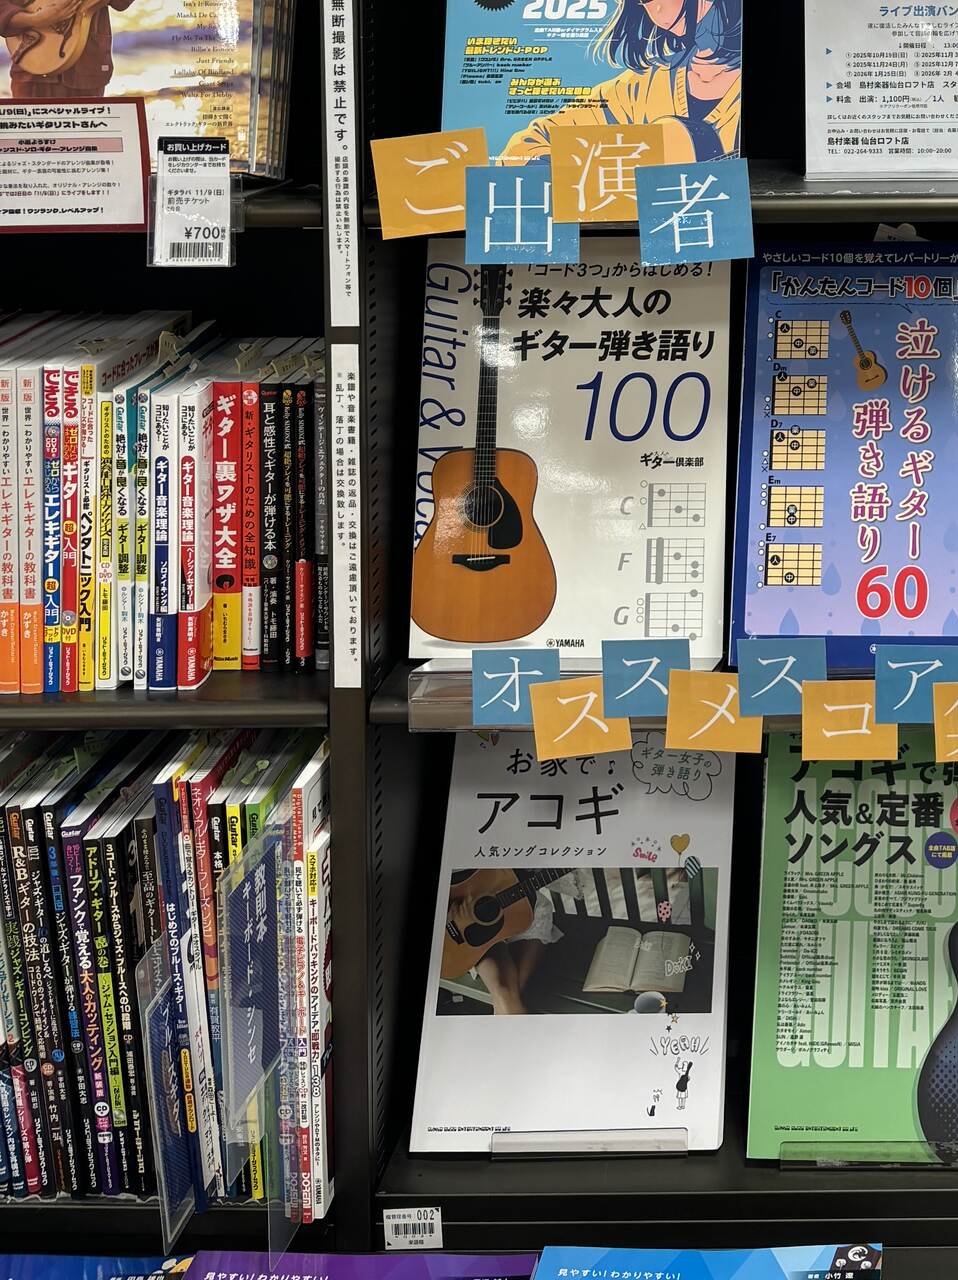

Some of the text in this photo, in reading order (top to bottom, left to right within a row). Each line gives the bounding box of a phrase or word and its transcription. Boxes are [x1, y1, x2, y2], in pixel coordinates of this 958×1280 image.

[836, 81, 851, 89] 会場
[859, 81, 935, 89] 島村楽器仙台ロフト店
[836, 95, 851, 103] 料金
[166, 143, 227, 152] お買い上げカード
[827, 137, 909, 145] 島村楽器 仙台ロフト店
[403, 133, 730, 254] ご出演者
[184, 227, 220, 239] ¥700
[517, 287, 672, 319] 楽々大人の
[512, 329, 716, 362] ギター弾き語り
[44, 370, 61, 418] できる
[575, 371, 712, 442] 100
[896, 319, 940, 561] 泣けるギター
[639, 452, 704, 469] ギター倶楽部
[214, 393, 237, 569] ギター裏ワザ大全
[851, 399, 893, 565] 弾き語り
[856, 565, 929, 620] 60
[556, 638, 585, 648] YAMAHA
[640, 746, 712, 770] ギター女子の
[651, 763, 702, 783] 弾き語り
[475, 782, 625, 835] アコギ
[783, 789, 945, 828] 人気&定番
[474, 845, 607, 858] 人気ソングコレクション
[787, 831, 917, 866] ソングス
[417, 1210, 434, 1220] 002
